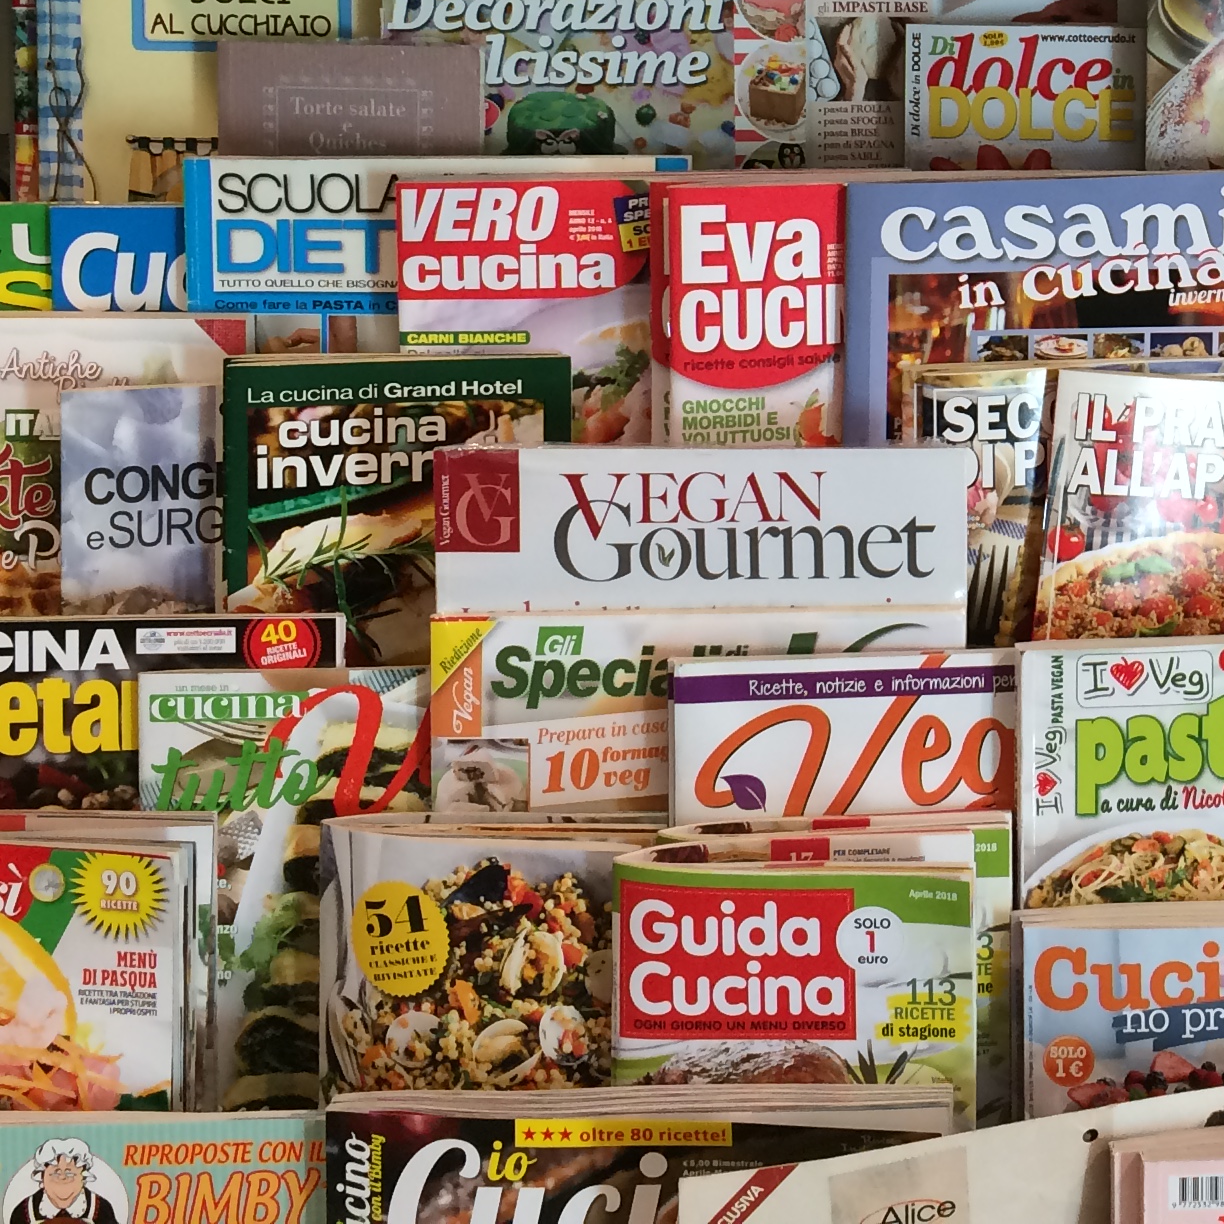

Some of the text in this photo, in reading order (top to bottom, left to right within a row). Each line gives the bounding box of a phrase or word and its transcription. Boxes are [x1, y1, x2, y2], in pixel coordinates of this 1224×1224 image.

[150, 13, 332, 37] AL CUCCHIAIO
[1040, 32, 1137, 46] www.cottoecrudo.it
[400, 186, 559, 244] VERO
[402, 245, 616, 291] cucina
[958, 275, 1005, 310] in
[406, 331, 527, 345] CARNI BIANCHE
[248, 378, 523, 405] La cucina di Grand Hotel
[1075, 392, 1116, 441] IL
[261, 620, 296, 645] 40
[748, 671, 986, 698] Ricette, notizie e informazioni
[452, 666, 480, 734] Vegan
[1099, 797, 1113, 813] a
[1116, 792, 1156, 812] cura
[1159, 789, 1178, 810] di
[101, 869, 138, 896] 90
[627, 899, 822, 958] Guida
[117, 949, 157, 969] MENÙ
[82, 969, 157, 989] DI PASQUA
[633, 962, 846, 1019] Cucina
[579, 1128, 727, 1143] oltre 80 ricette!
[124, 1140, 326, 1166] RIPROPOSTE CON IL
